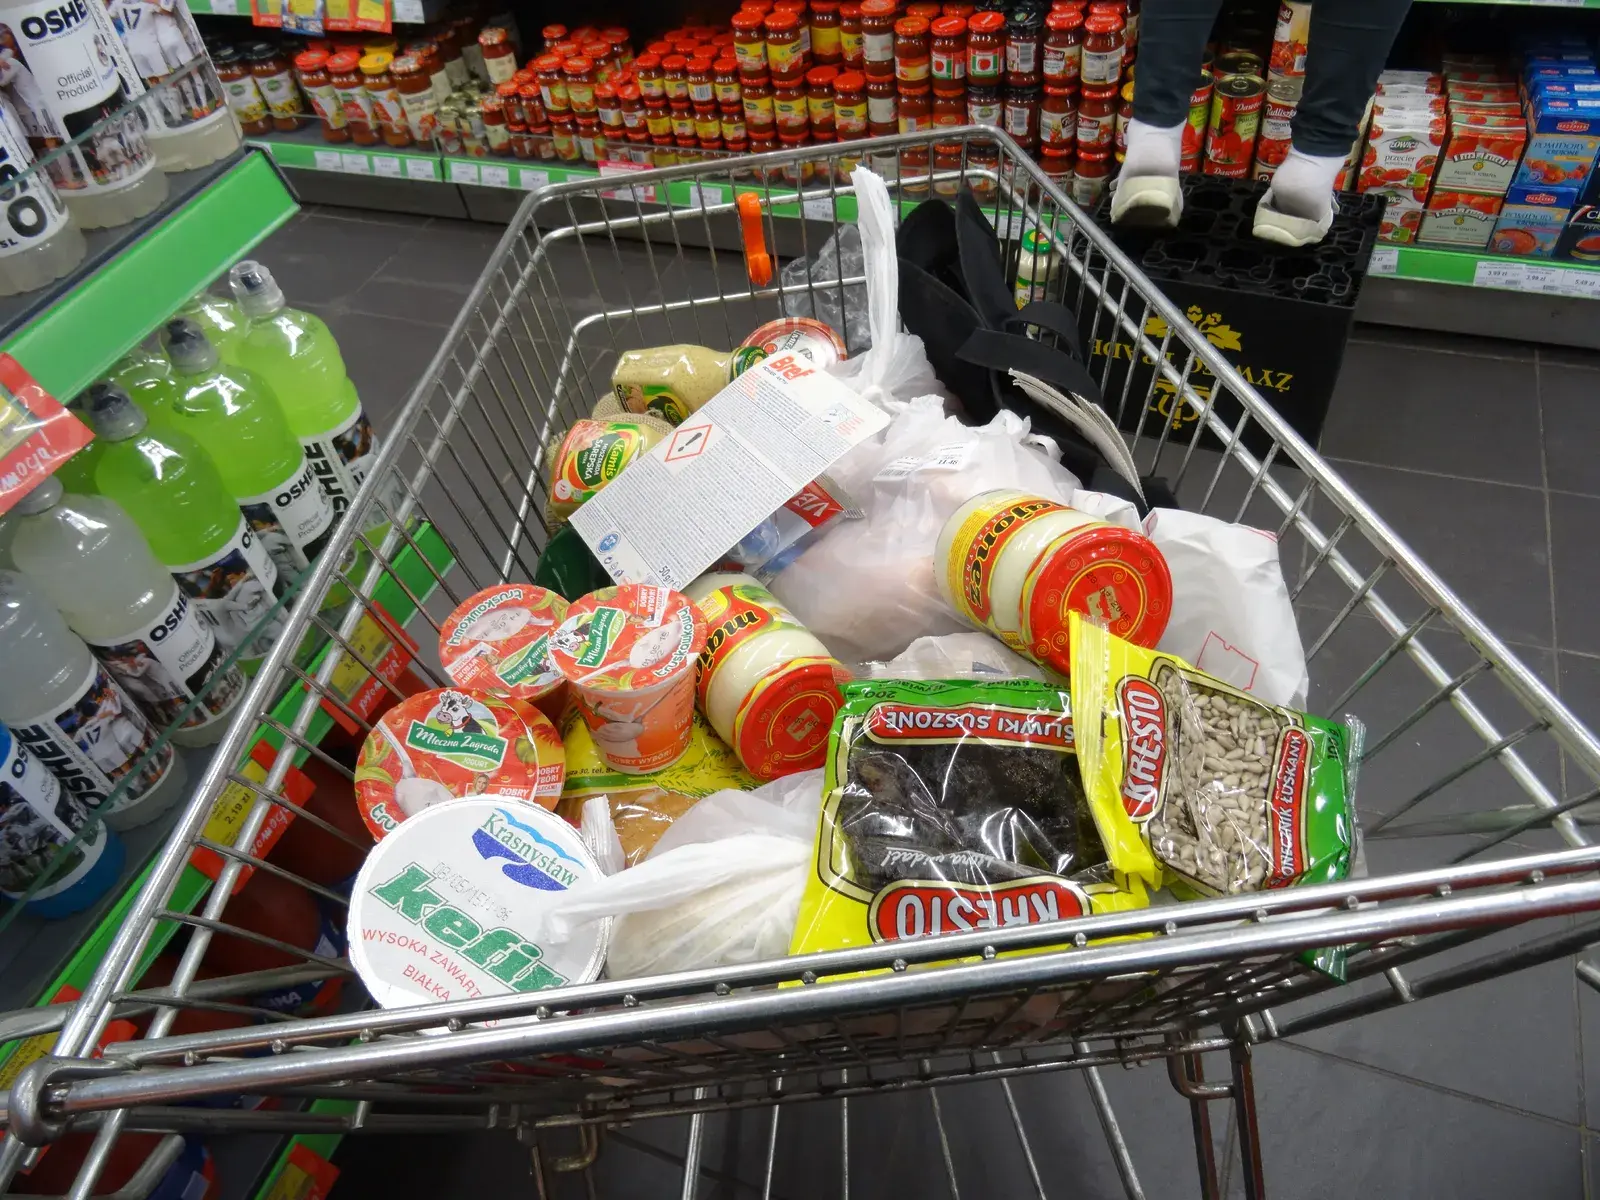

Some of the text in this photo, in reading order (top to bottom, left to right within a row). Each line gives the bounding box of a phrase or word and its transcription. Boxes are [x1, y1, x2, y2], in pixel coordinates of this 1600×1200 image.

[56, 78, 99, 101] Product
[57, 66, 93, 88] Official
[1385, 154, 1417, 163] przecier
[770, 355, 816, 381] Bref
[583, 438, 604, 480] SAREPSKA
[605, 442, 626, 478] Kamis
[653, 606, 694, 677] truskawkowy
[885, 709, 990, 730] SUSZONE
[415, 726, 500, 756] Mleczna Zagroda
[1123, 689, 1165, 804] KRESTO
[463, 757, 489, 768] JOGURT
[499, 786, 530, 798] DOBRY
[480, 813, 580, 888] Krasnystaw
[361, 928, 429, 957] WYSOKA
[402, 964, 452, 1003] BIAŁKA
